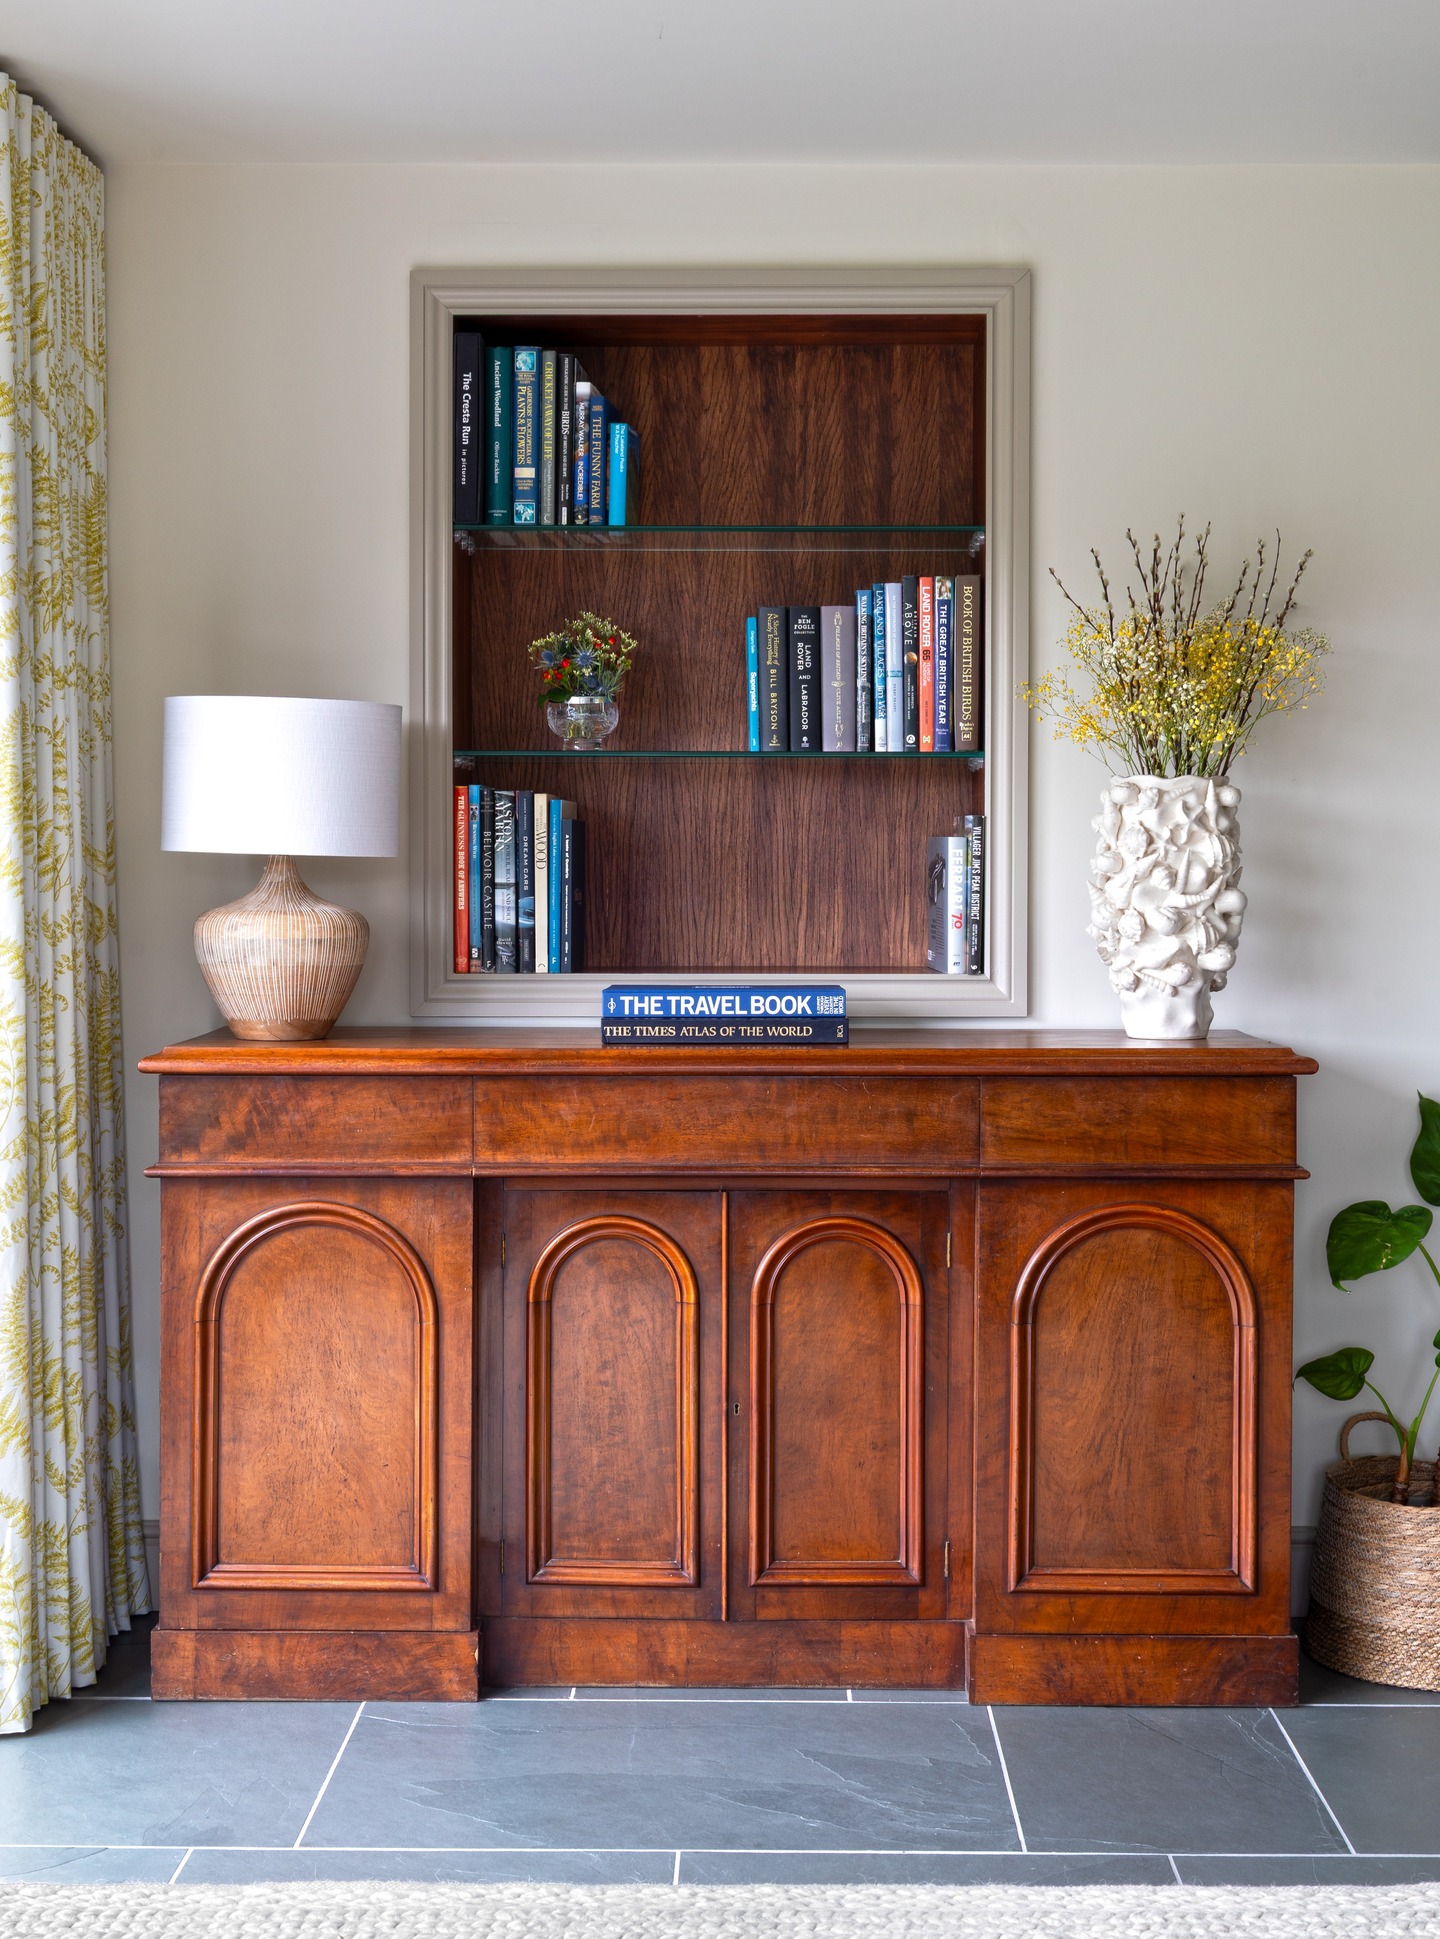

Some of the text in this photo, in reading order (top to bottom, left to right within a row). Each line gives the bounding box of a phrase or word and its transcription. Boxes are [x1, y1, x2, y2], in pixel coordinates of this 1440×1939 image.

[463, 372, 472, 390] The
[462, 393, 472, 423] Cresta
[518, 386, 526, 417] PLANTS
[462, 426, 470, 444] Run
[517, 426, 526, 465] FLOWERS
[544, 427, 552, 440] OF
[544, 440, 552, 460] LIFE
[592, 417, 602, 508] THE FUNNY FARM
[876, 590, 884, 634] LAKELAND
[963, 586, 972, 618] BOOK
[904, 602, 912, 645] ABOVE
[922, 586, 930, 660] LAND ROVER 65
[963, 620, 972, 636] OF
[962, 638, 972, 682] BRITISH
[939, 660, 947, 696] BRITISH
[938, 699, 946, 724] YEAR
[962, 686, 972, 720] BIRDS
[495, 801, 504, 852] MARTIN
[503, 800, 512, 844] ASTON
[536, 831, 547, 870] WOOD
[972, 826, 982, 856] VILLAGER
[458, 870, 465, 879] OF
[484, 831, 492, 930] BELVOIR CASTLE
[972, 858, 980, 874] JIM'S
[952, 848, 964, 928] FERRARI 70
[972, 876, 980, 892] PEAK
[971, 894, 980, 920] DISTRICT
[620, 996, 664, 1014] THE
[666, 996, 748, 1014] TRAVEL
[750, 996, 812, 1014] BOOK
[834, 1006, 838, 1014] IN
[604, 1026, 812, 1036] THE TIMES ATLAS OF THE WORLD
